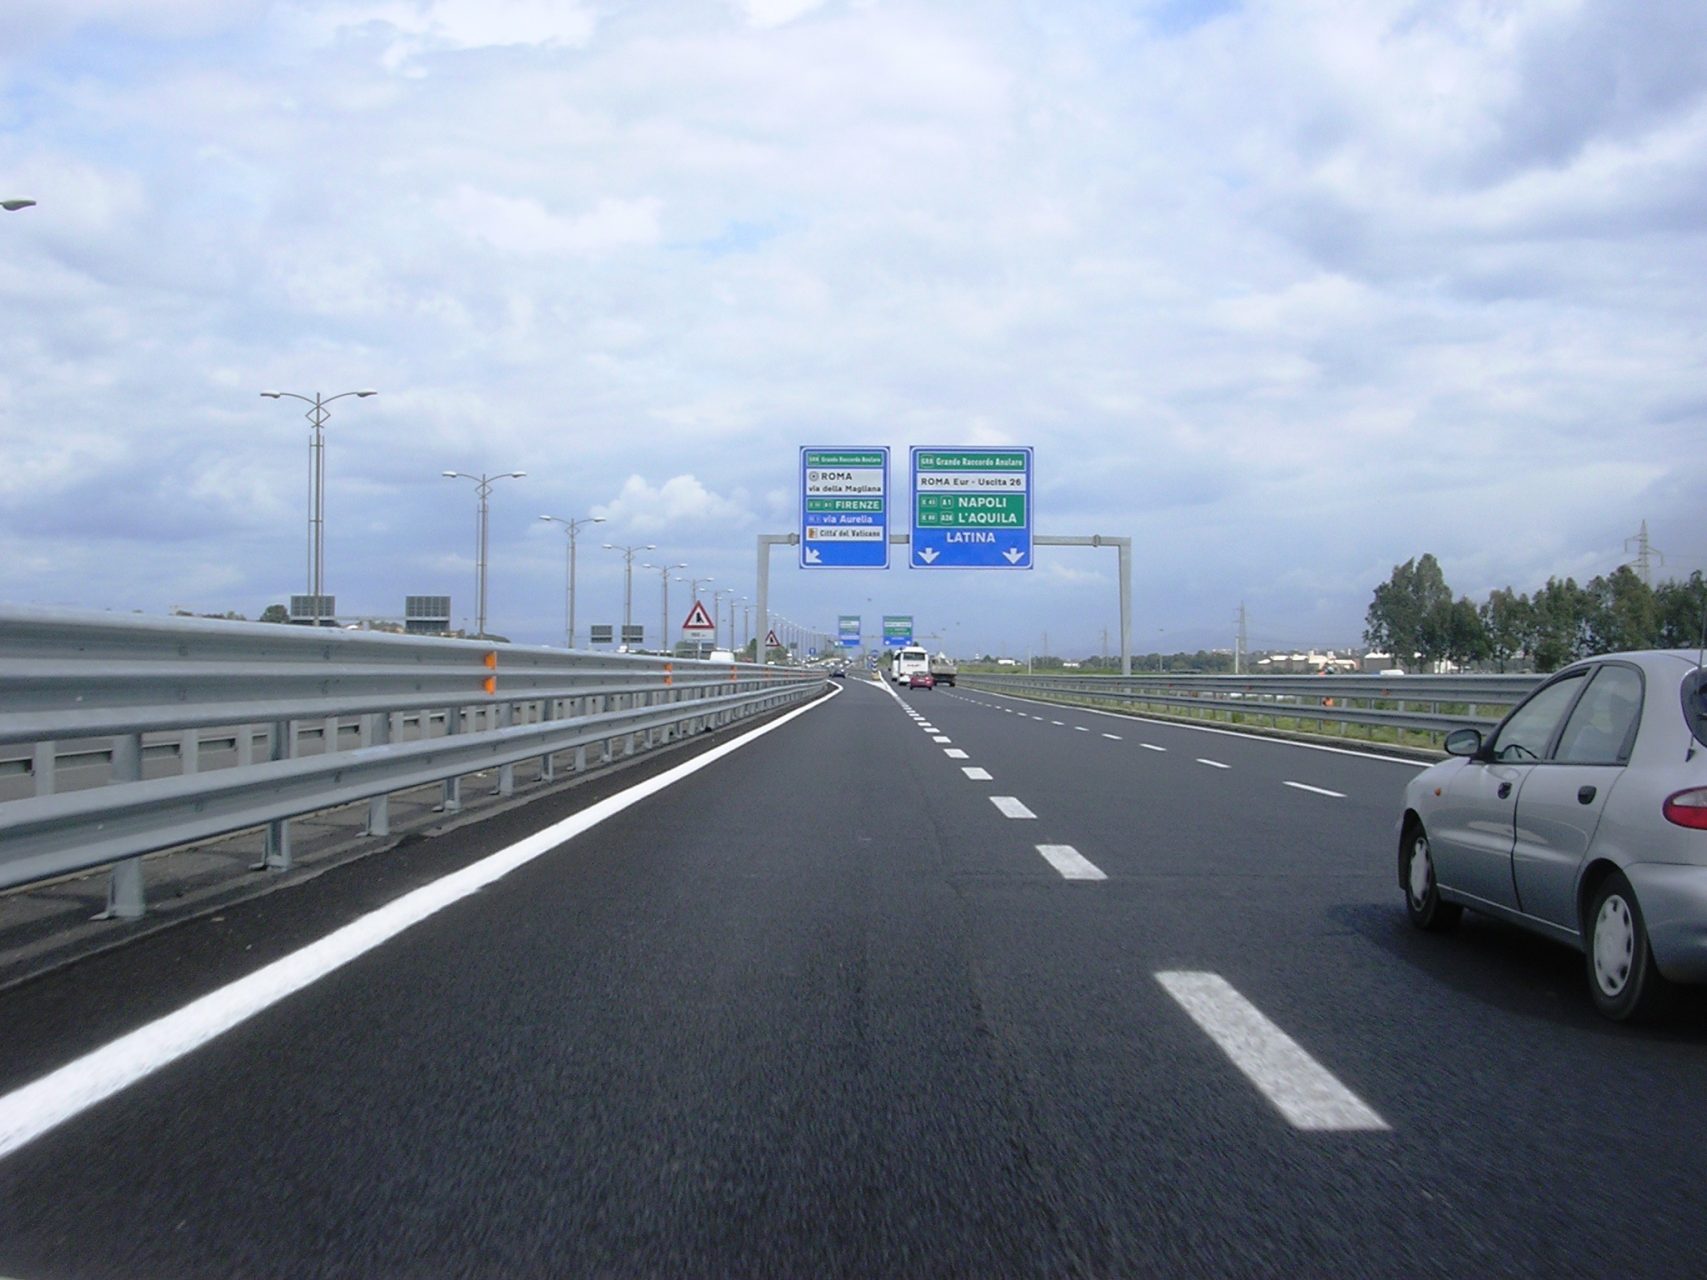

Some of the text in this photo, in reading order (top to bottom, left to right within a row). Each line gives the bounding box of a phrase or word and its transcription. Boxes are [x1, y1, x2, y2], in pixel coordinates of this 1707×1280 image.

[936, 458, 960, 466] Grande
[962, 458, 994, 466] Raccordo
[996, 458, 1022, 466] Anulare
[821, 472, 852, 480] ROMA
[920, 478, 950, 486] ROMA
[978, 478, 1007, 486] Uscita
[836, 501, 880, 509] FIRENZE
[958, 498, 1006, 507] NAPOLI
[823, 515, 836, 523] via
[840, 515, 872, 523] Aurelia
[958, 513, 1016, 523] L'AQUILA
[946, 532, 996, 542] LATINA
